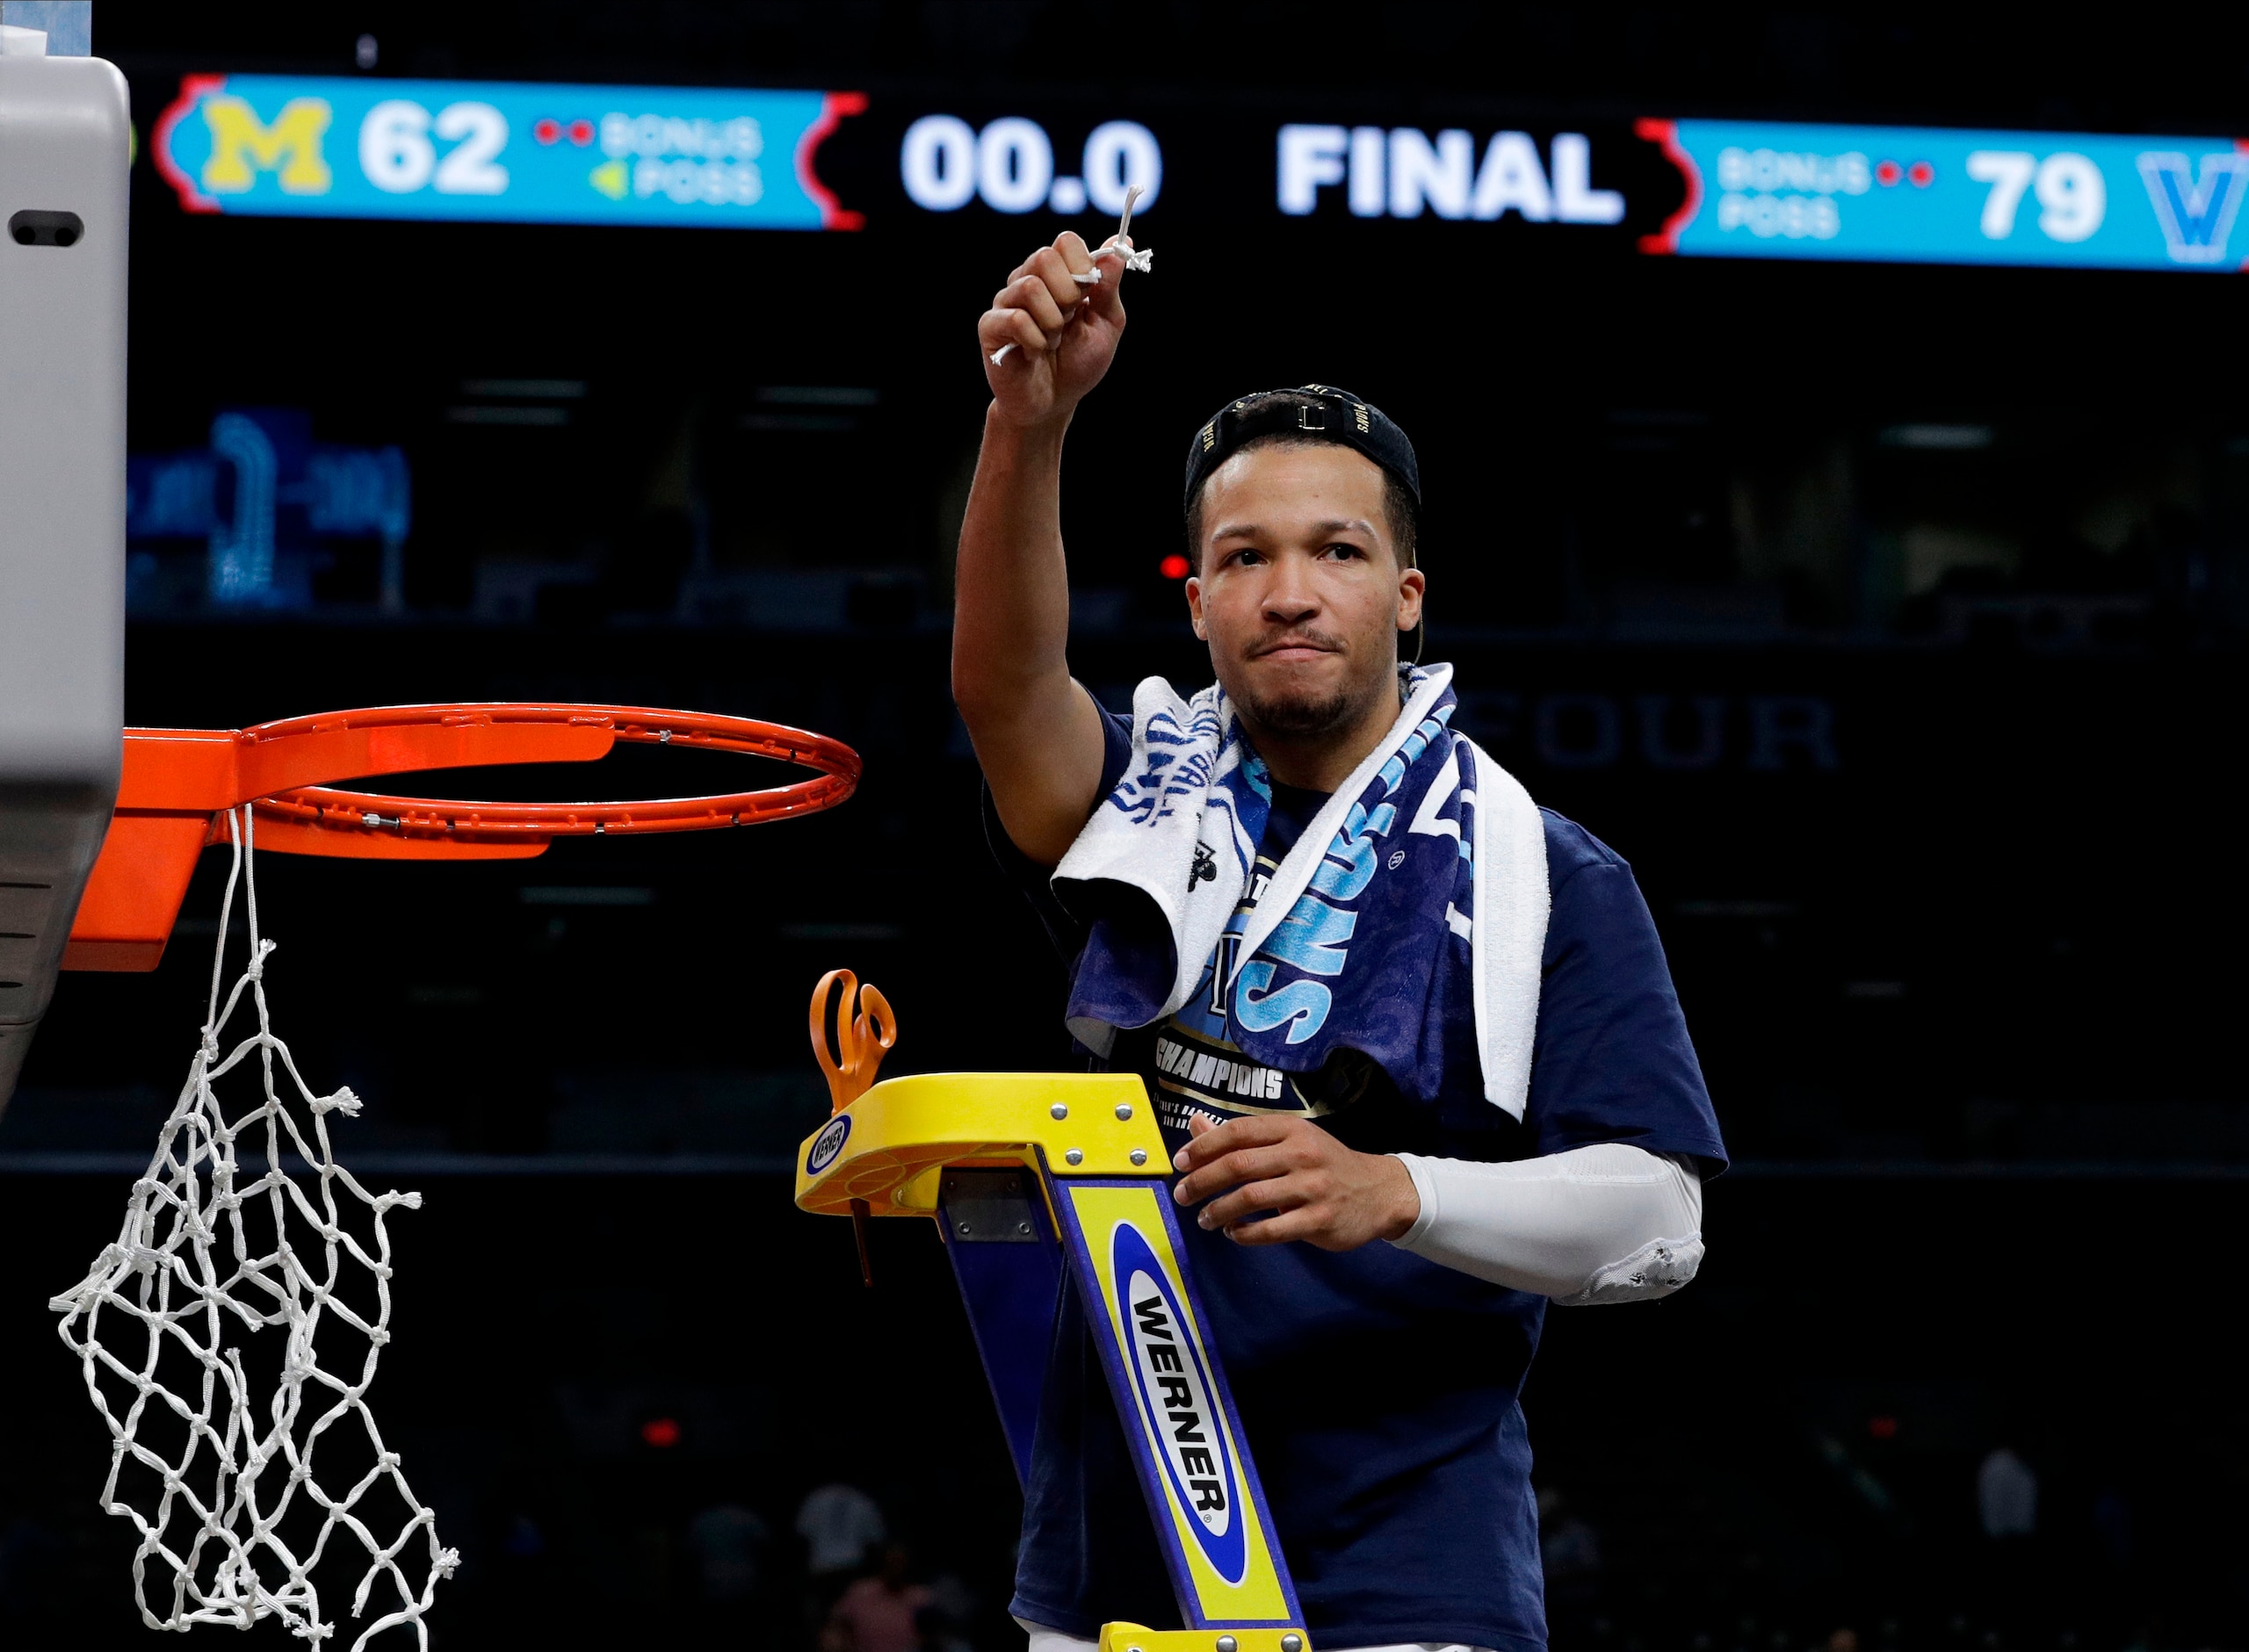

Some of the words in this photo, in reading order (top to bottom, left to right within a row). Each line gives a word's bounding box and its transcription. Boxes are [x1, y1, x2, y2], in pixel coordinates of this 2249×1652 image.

[358, 99, 510, 196] 62
[600, 112, 763, 161] BONUS
[901, 115, 1162, 217] 00.0
[1276, 123, 1625, 225] FINAL
[1717, 147, 1870, 196] BONUS
[633, 159, 763, 206] POSS
[1717, 191, 1840, 240] POSS
[1965, 149, 2107, 242] 79
[1156, 1037, 1284, 1100] CHAMPIONS
[1133, 1295, 1226, 1512] WERNER
